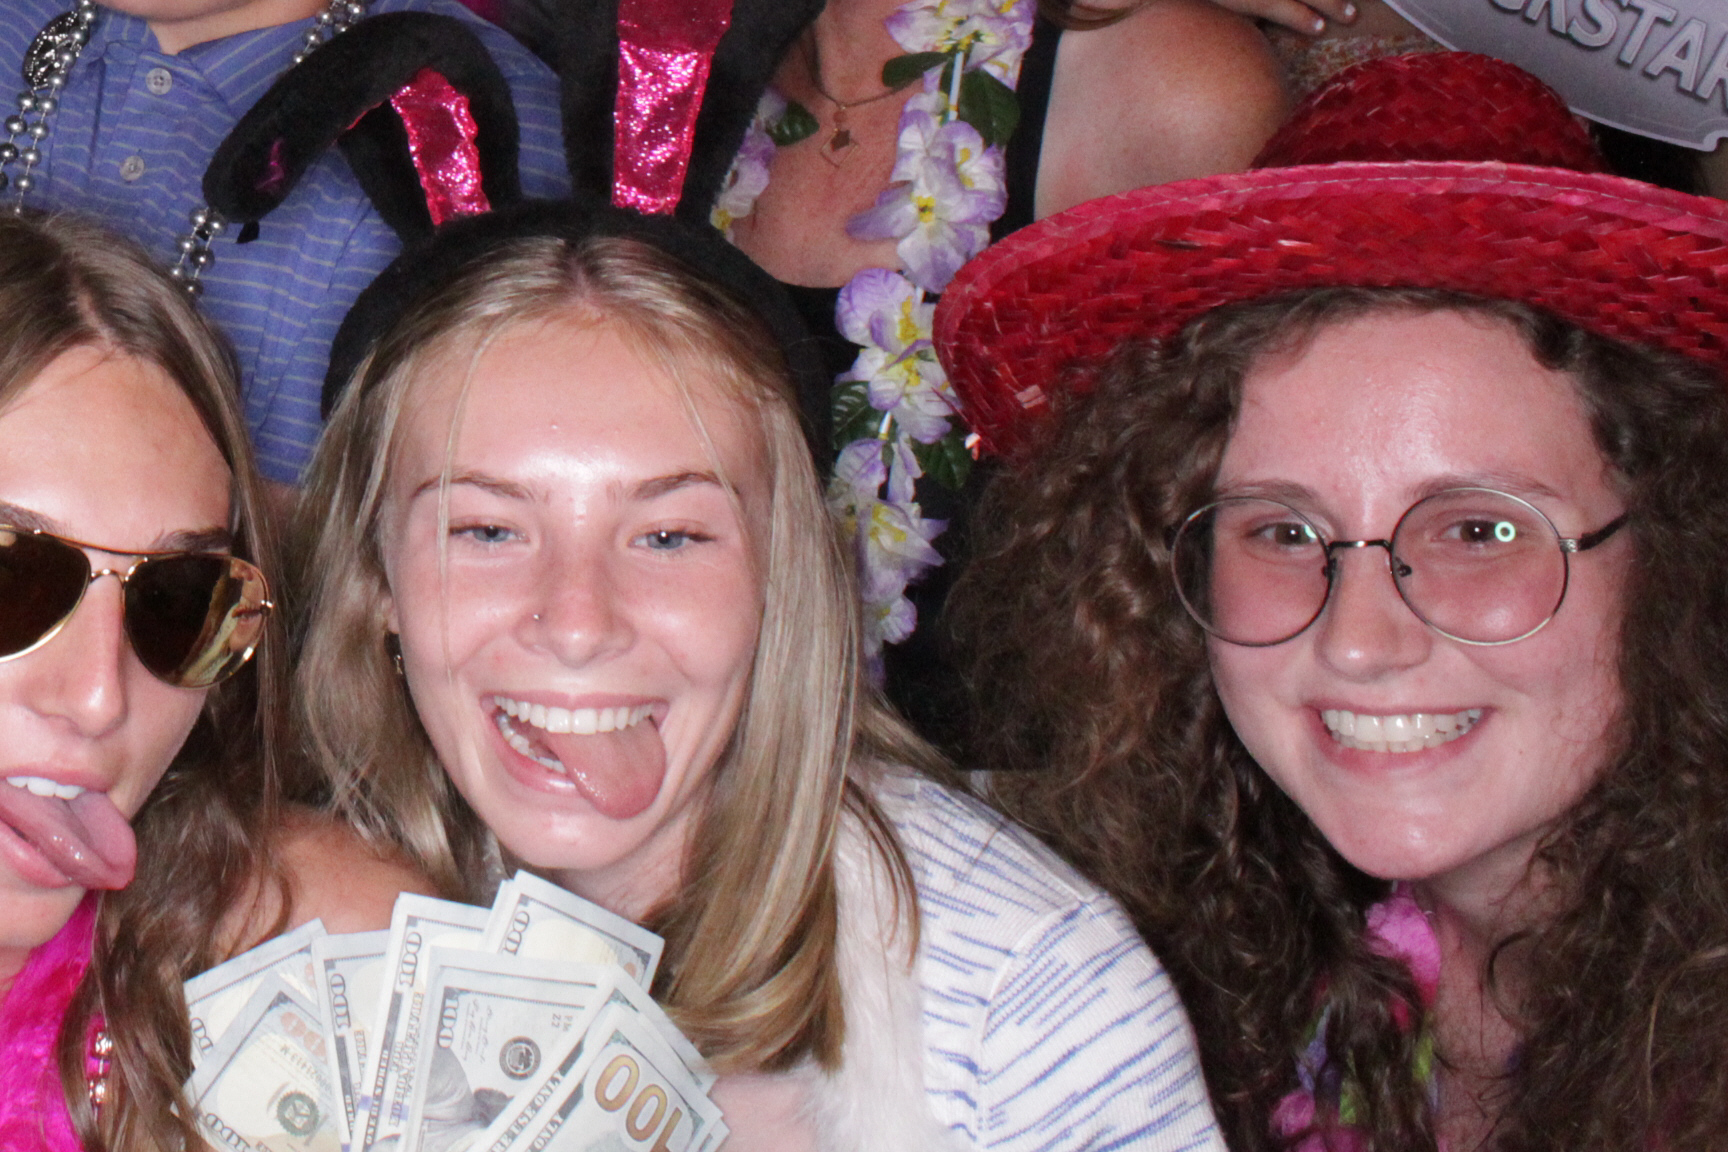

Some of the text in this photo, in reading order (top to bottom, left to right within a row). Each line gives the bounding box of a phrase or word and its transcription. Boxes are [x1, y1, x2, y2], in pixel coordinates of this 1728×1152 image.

[397, 930, 423, 987] 100
[330, 973, 351, 1029] 100
[438, 997, 460, 1049] 100
[280, 1012, 327, 1059] 00
